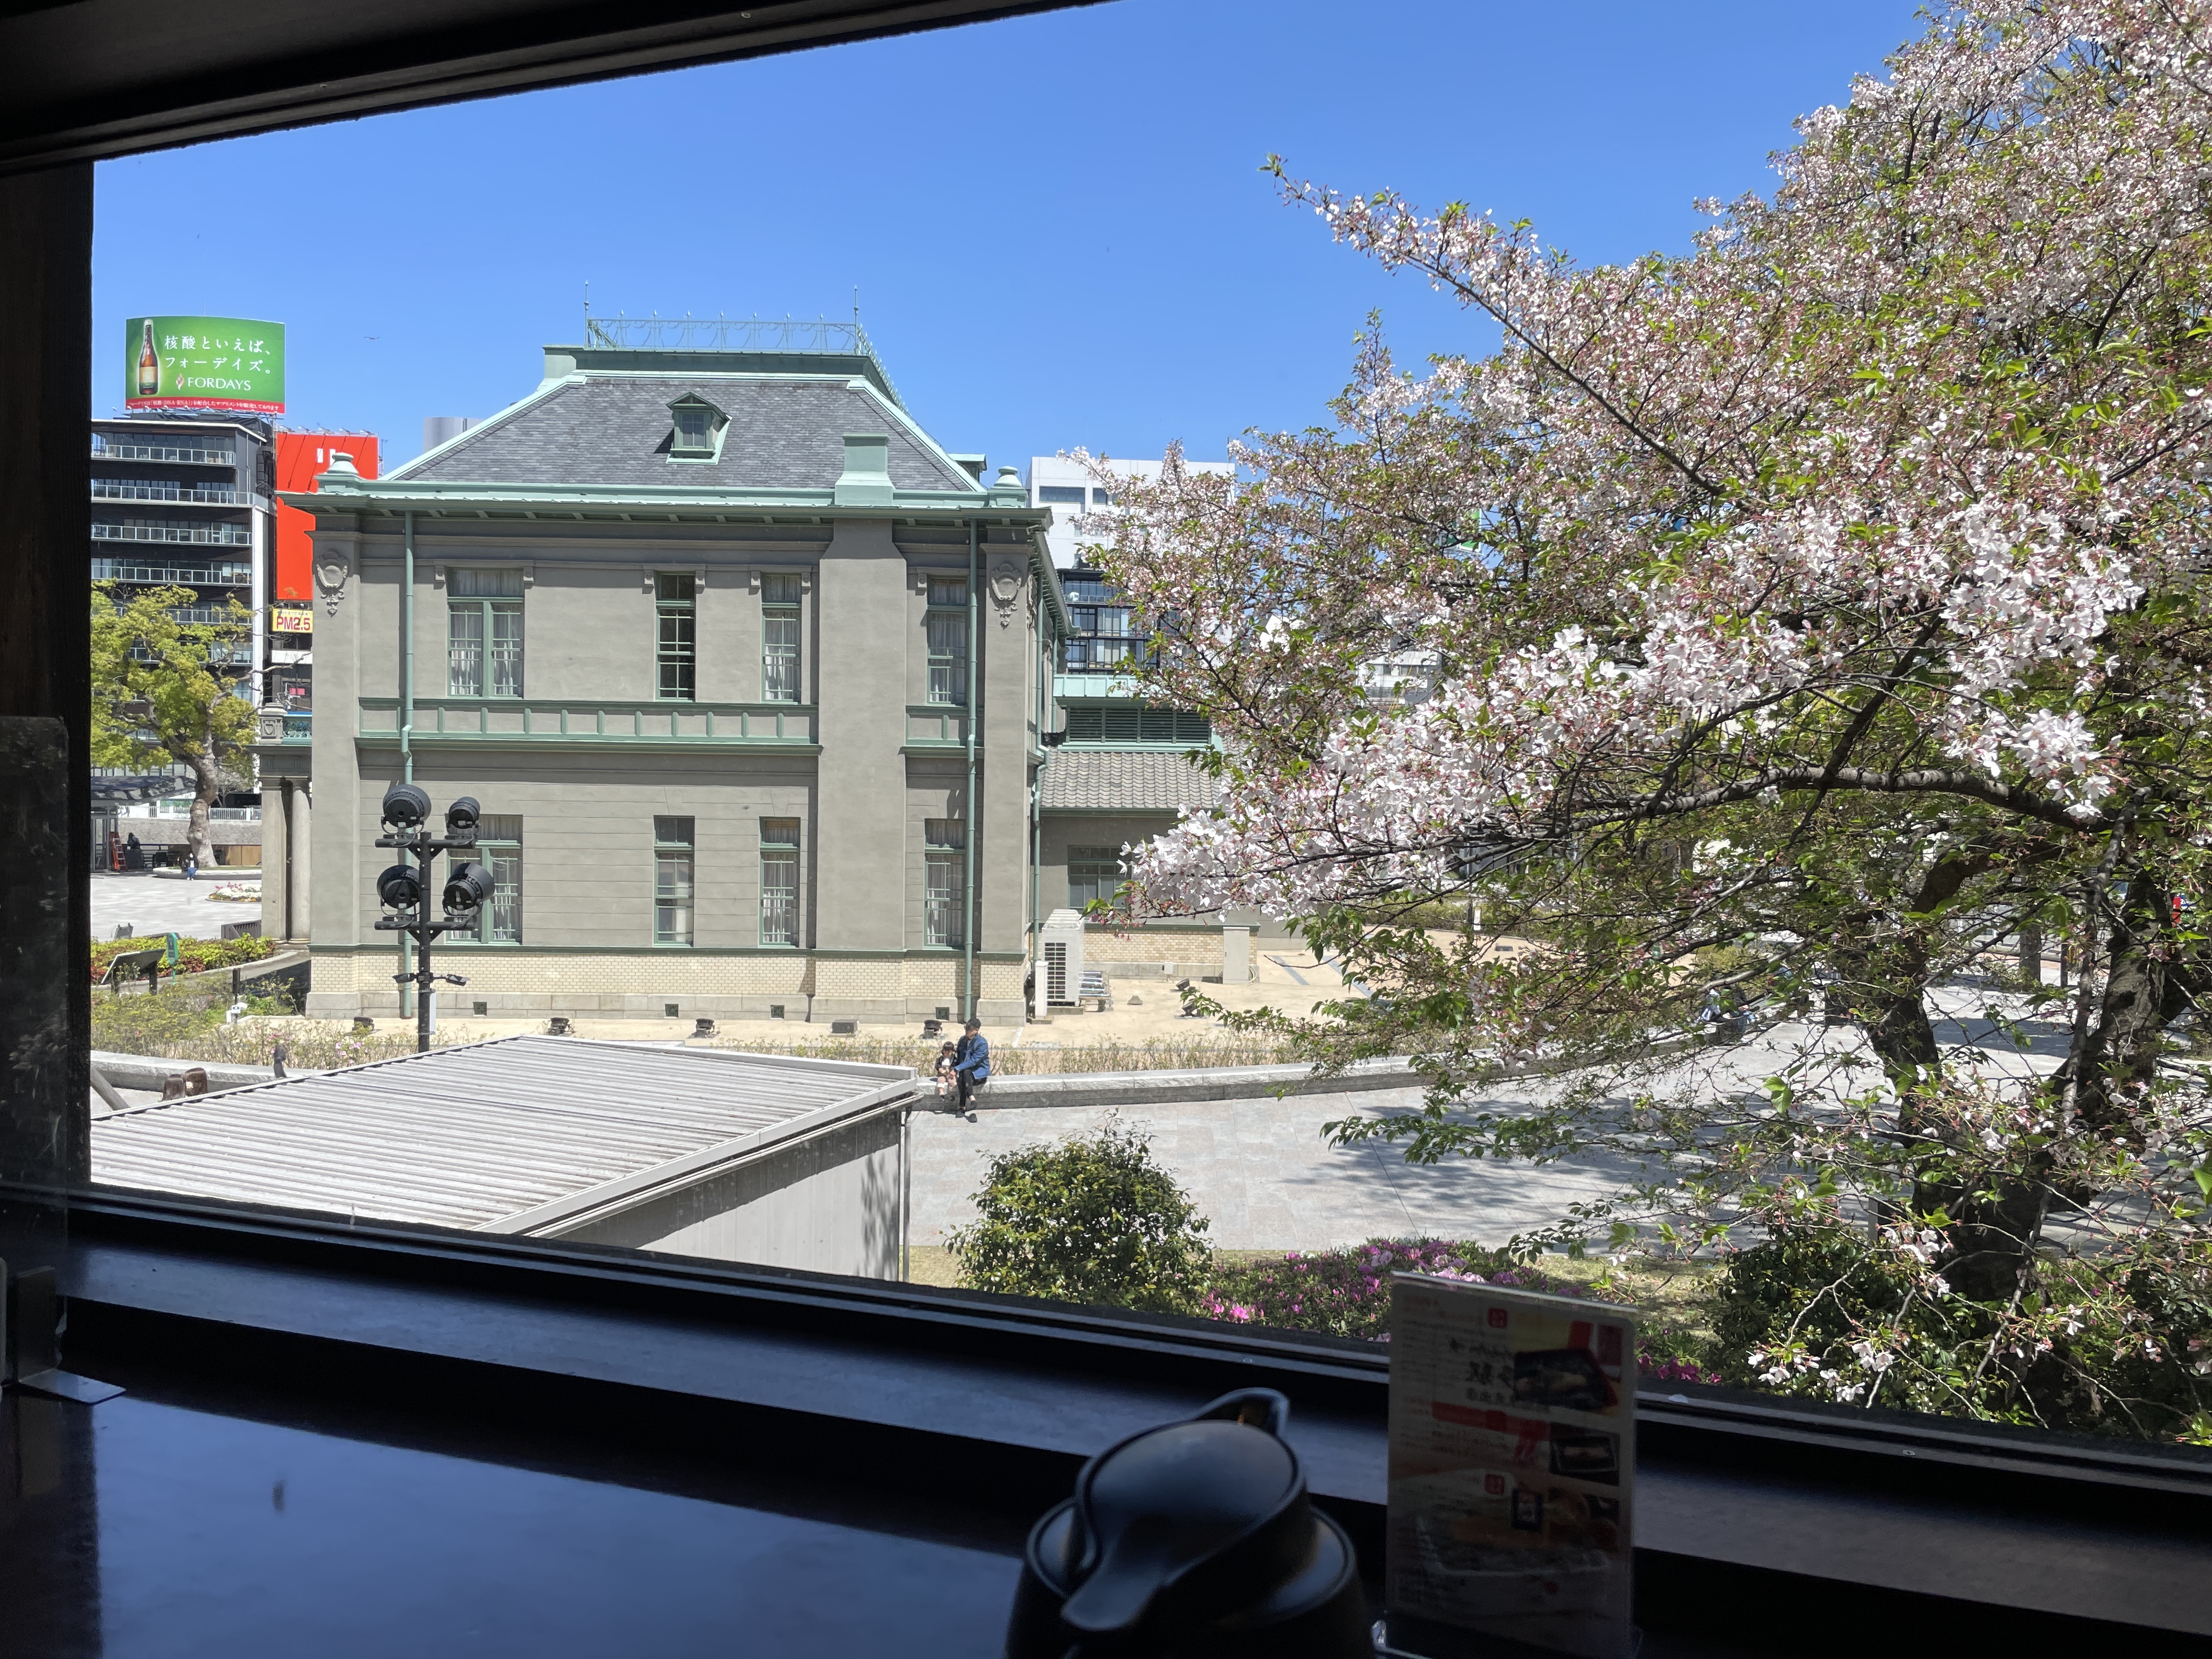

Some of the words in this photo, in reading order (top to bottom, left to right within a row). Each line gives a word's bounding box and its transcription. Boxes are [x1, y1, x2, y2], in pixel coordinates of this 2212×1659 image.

[165, 335, 270, 355] 核酸といえば、
[166, 357, 270, 374] フォーデイズ。
[188, 377, 251, 391] FORDAYS
[276, 616, 311, 631] PM2.5
